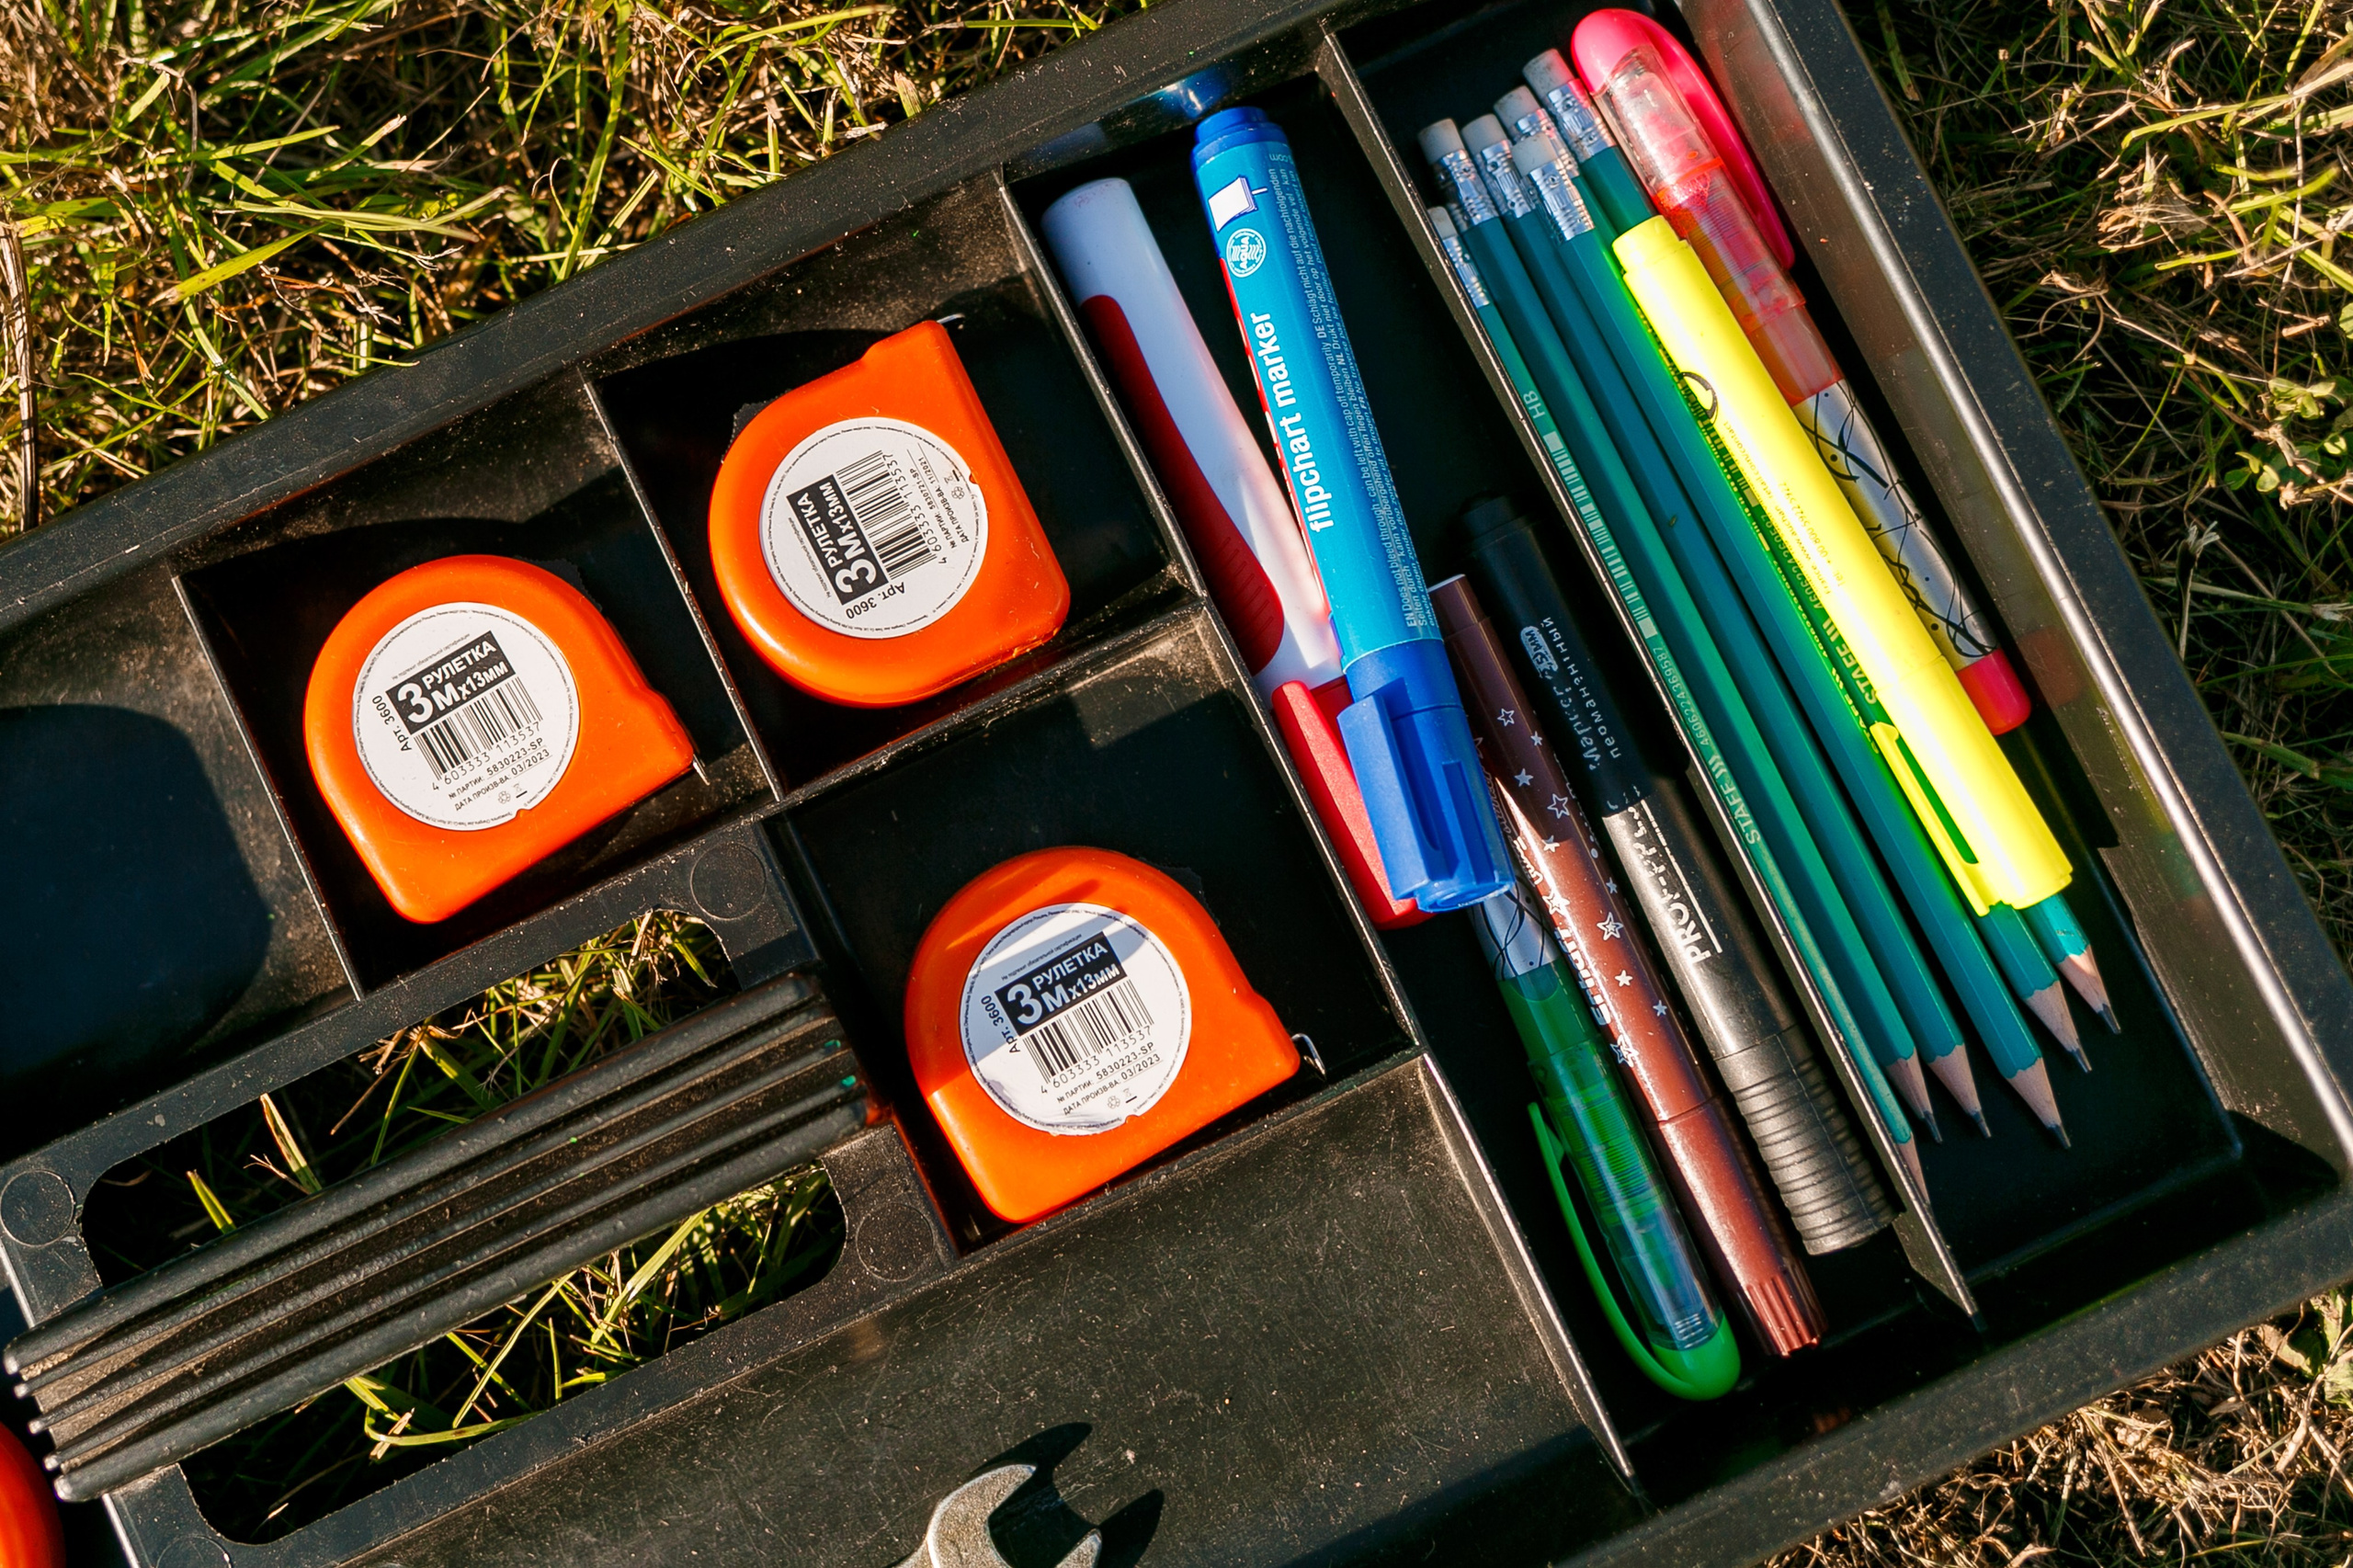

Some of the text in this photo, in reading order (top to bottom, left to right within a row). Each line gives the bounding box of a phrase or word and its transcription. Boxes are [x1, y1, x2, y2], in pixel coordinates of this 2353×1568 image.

[1278, 167, 1290, 187] kan
[1285, 191, 1297, 207] vel
[1290, 207, 1310, 248] volgende
[1239, 234, 1249, 271] AQUA
[1302, 249, 1315, 267] het
[1309, 266, 1320, 280] op
[1312, 280, 1326, 303] door
[1319, 302, 1333, 323] niet
[1325, 323, 1341, 351] Drukt
[1250, 312, 1296, 407] marker
[1335, 350, 1346, 366] NL
[1266, 166, 1417, 628] EN Does not bleed through can be left with cap off temporarily DE Schlägt nicht auf die nachfolgenden
[1339, 366, 1357, 402] bleiben
[1350, 402, 1367, 433] liegen
[1523, 390, 1545, 418] HB
[1359, 432, 1375, 460] offen
[881, 449, 915, 500] 113537
[908, 465, 936, 511] 5830721-SP
[916, 455, 937, 485] 11/2021
[1279, 412, 1334, 532] flipchart
[932, 483, 960, 526] ПРОИЗВ-ВА:
[1367, 459, 1399, 531] vorübergehend
[797, 492, 843, 567] РУЛЕТКА
[909, 502, 943, 553] 603333
[932, 509, 953, 540] ПАРТИИ:
[952, 522, 970, 544] ДАТА
[937, 554, 949, 566] 4
[1391, 532, 1405, 558] kann
[835, 559, 876, 593] 3
[878, 581, 904, 600] Арт.
[1401, 564, 1417, 594] durch
[846, 597, 877, 619] 3600
[421, 641, 496, 689] РУЛЕТКА
[371, 695, 394, 724] 3600
[397, 682, 433, 722] 3
[392, 725, 412, 751] Арт.
[429, 719, 543, 792] 4 603333 113537
[1651, 642, 1763, 846] STAFF 4606224369587
[453, 794, 473, 812] ДАТА
[471, 772, 512, 801] ПРОИЗВ-ВА:
[509, 746, 551, 777] 03/2023
[455, 773, 485, 795] ПАРТИИ:
[484, 735, 545, 777] 5830223-SP
[1032, 942, 1108, 990] РУЛЕТКА
[978, 992, 1006, 1028] 3600
[1007, 983, 1042, 1024] 3
[997, 1023, 1024, 1056] Арт.
[1038, 1084, 1049, 1096] 4
[1050, 1052, 1101, 1089] 603333
[1104, 1024, 1154, 1059] 113537
[1063, 1077, 1095, 1099] ПАРТИИ:
[1094, 1040, 1156, 1081] 5830223-SP
[1061, 1098, 1083, 1116] ДАТА
[1079, 1076, 1121, 1105] ПРОИЗВ-ВА:
[1120, 1051, 1162, 1081] 03/2023
